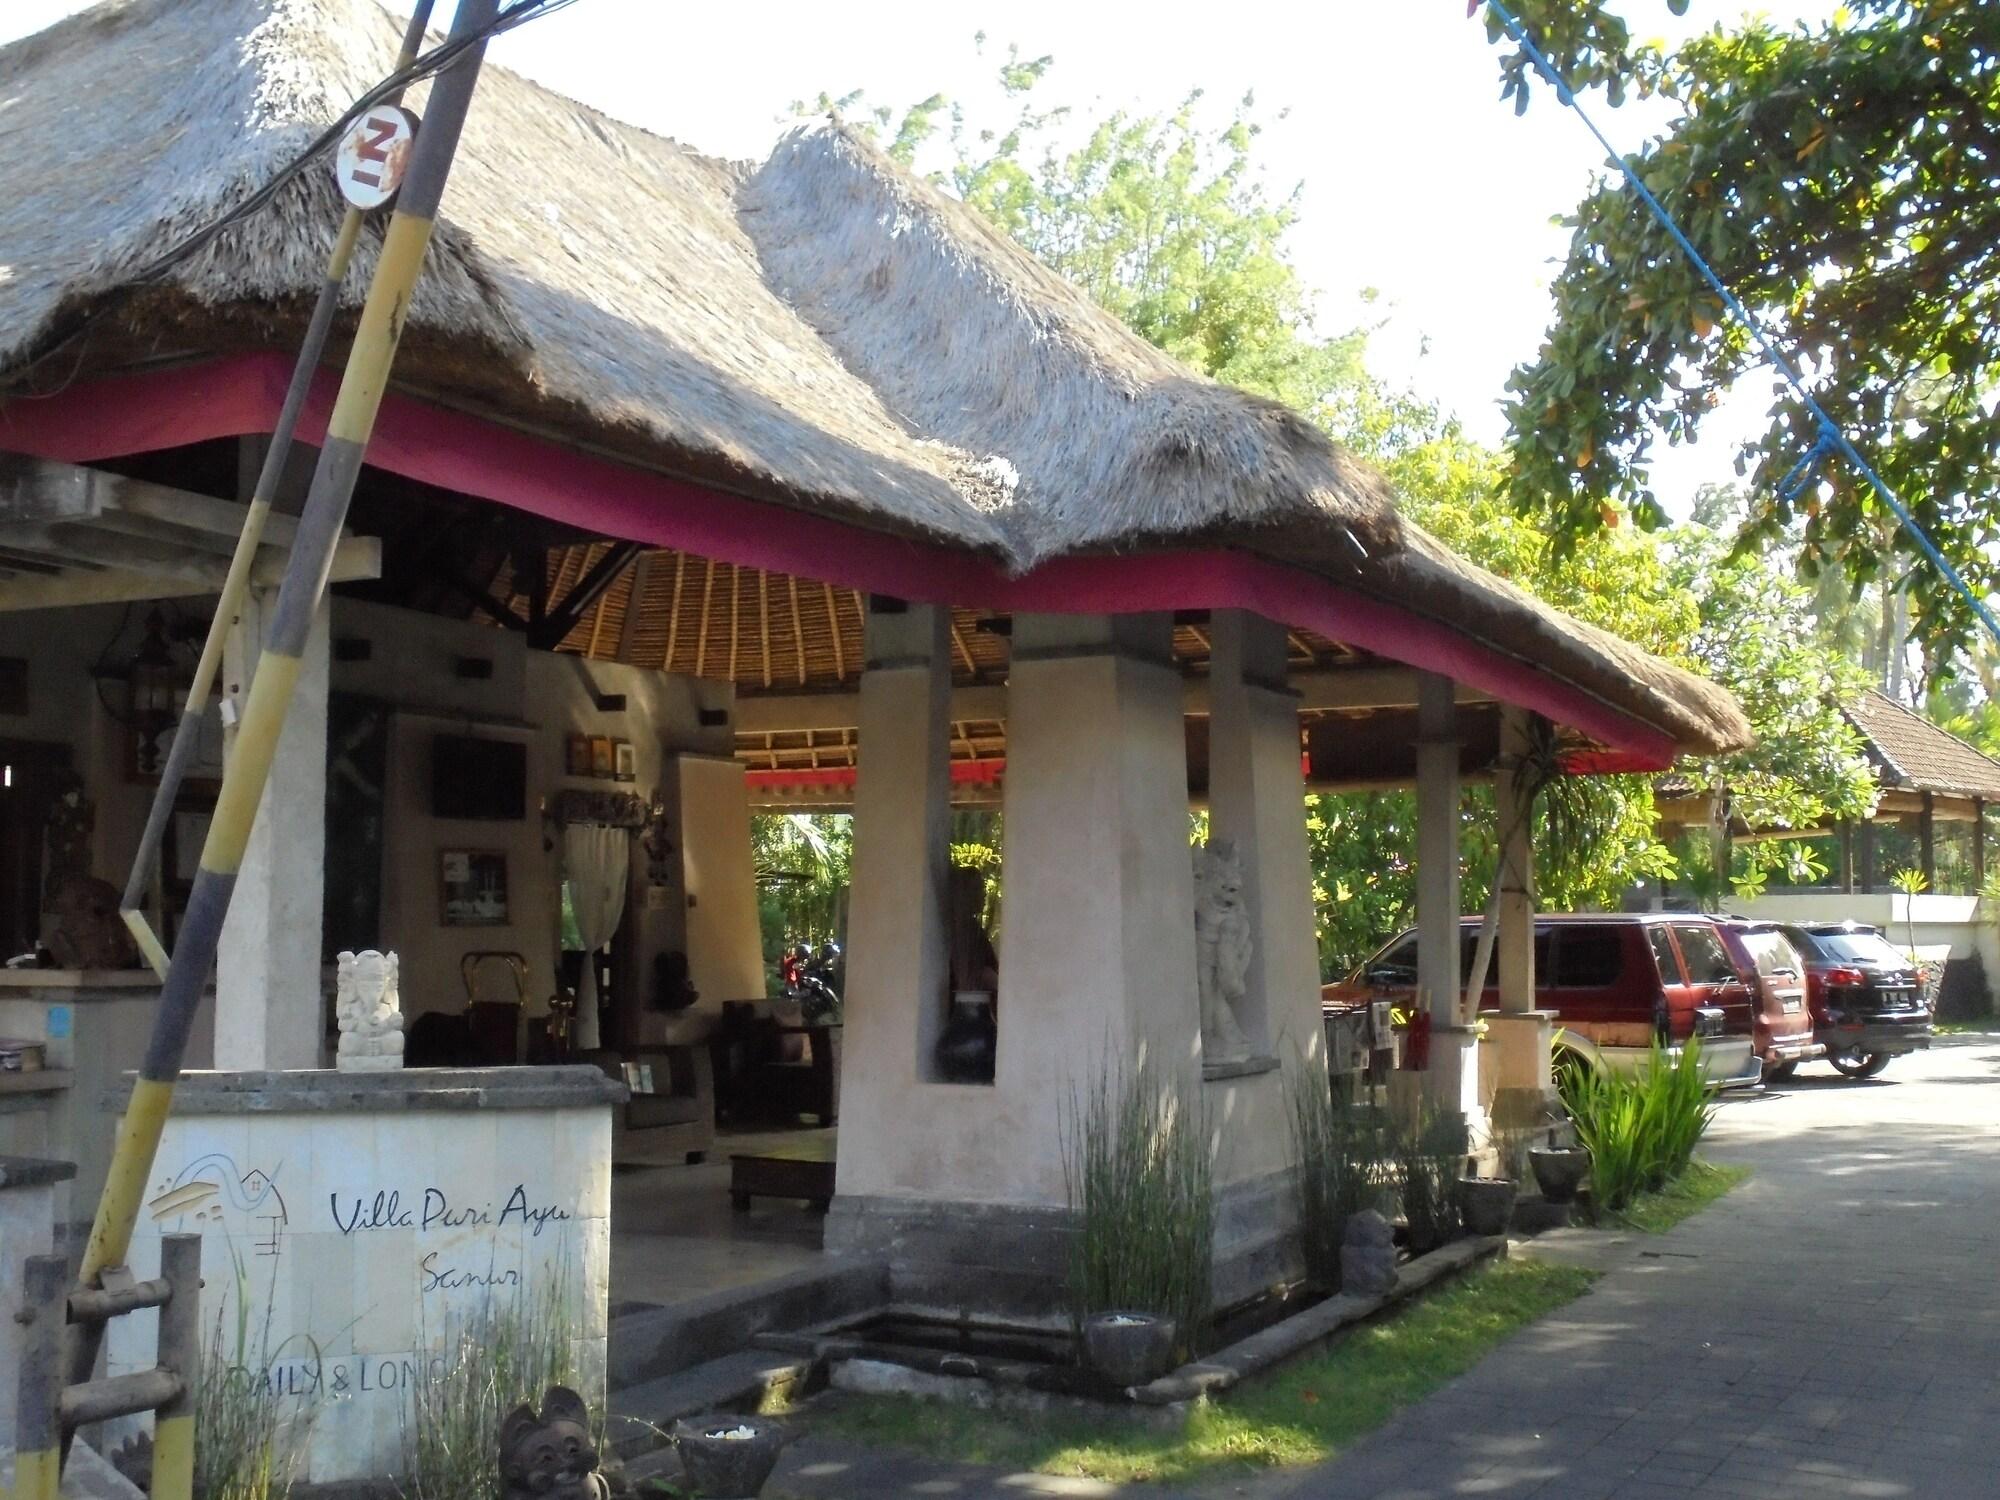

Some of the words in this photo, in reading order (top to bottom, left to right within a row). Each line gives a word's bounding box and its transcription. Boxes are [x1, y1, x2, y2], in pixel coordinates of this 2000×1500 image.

[350, 116, 399, 189] IN
[330, 1190, 414, 1235] Villa
[498, 1183, 571, 1236] Ayu
[421, 1251, 521, 1292] Sanur
[331, 1364, 350, 1392] &
